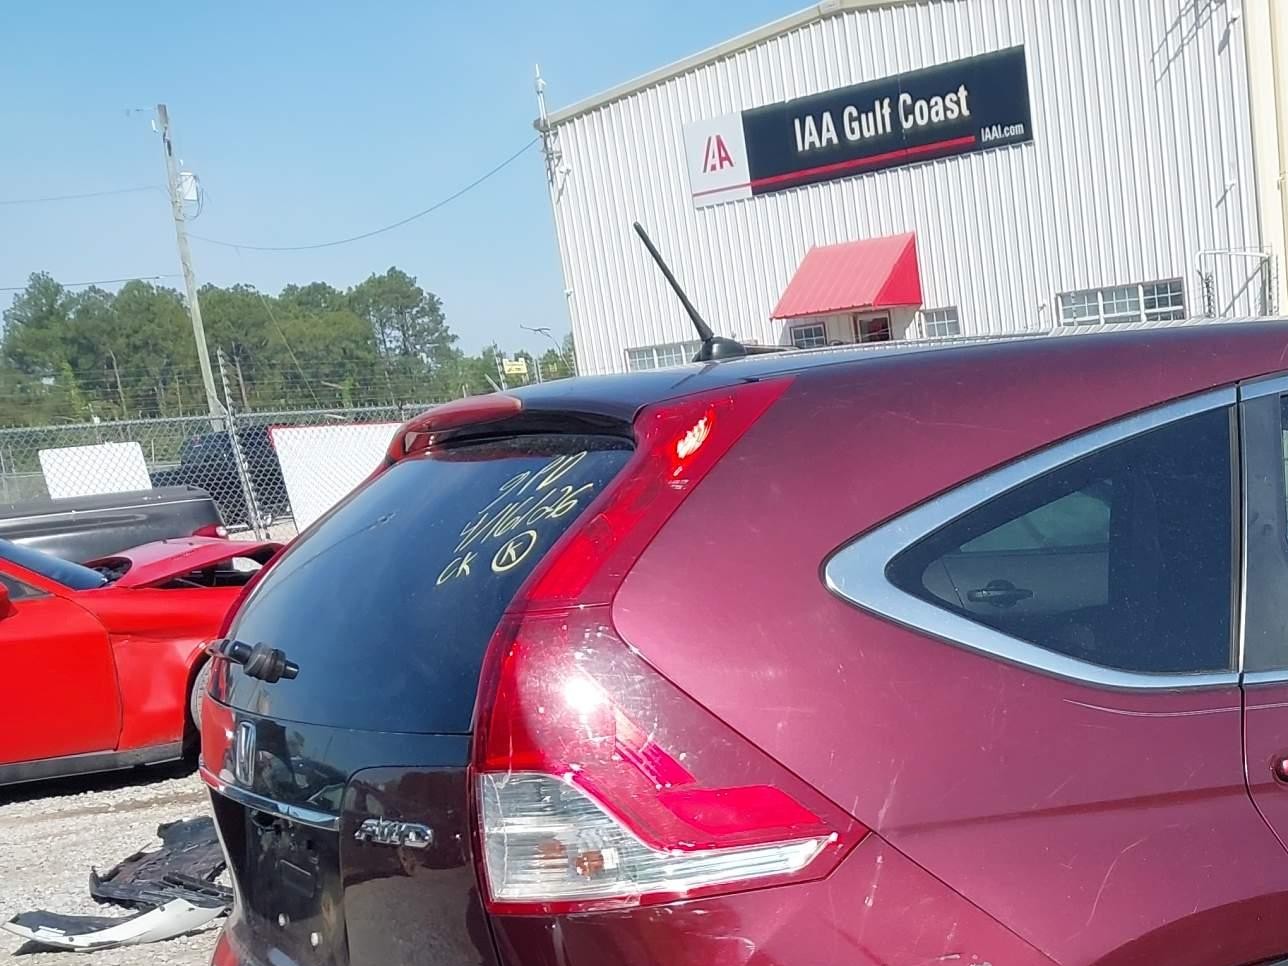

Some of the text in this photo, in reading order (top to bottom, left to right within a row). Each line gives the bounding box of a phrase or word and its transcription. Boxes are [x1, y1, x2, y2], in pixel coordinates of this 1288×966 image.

[794, 84, 971, 152] IAA Gulf Coast
[980, 122, 1025, 143] IAAI.com
